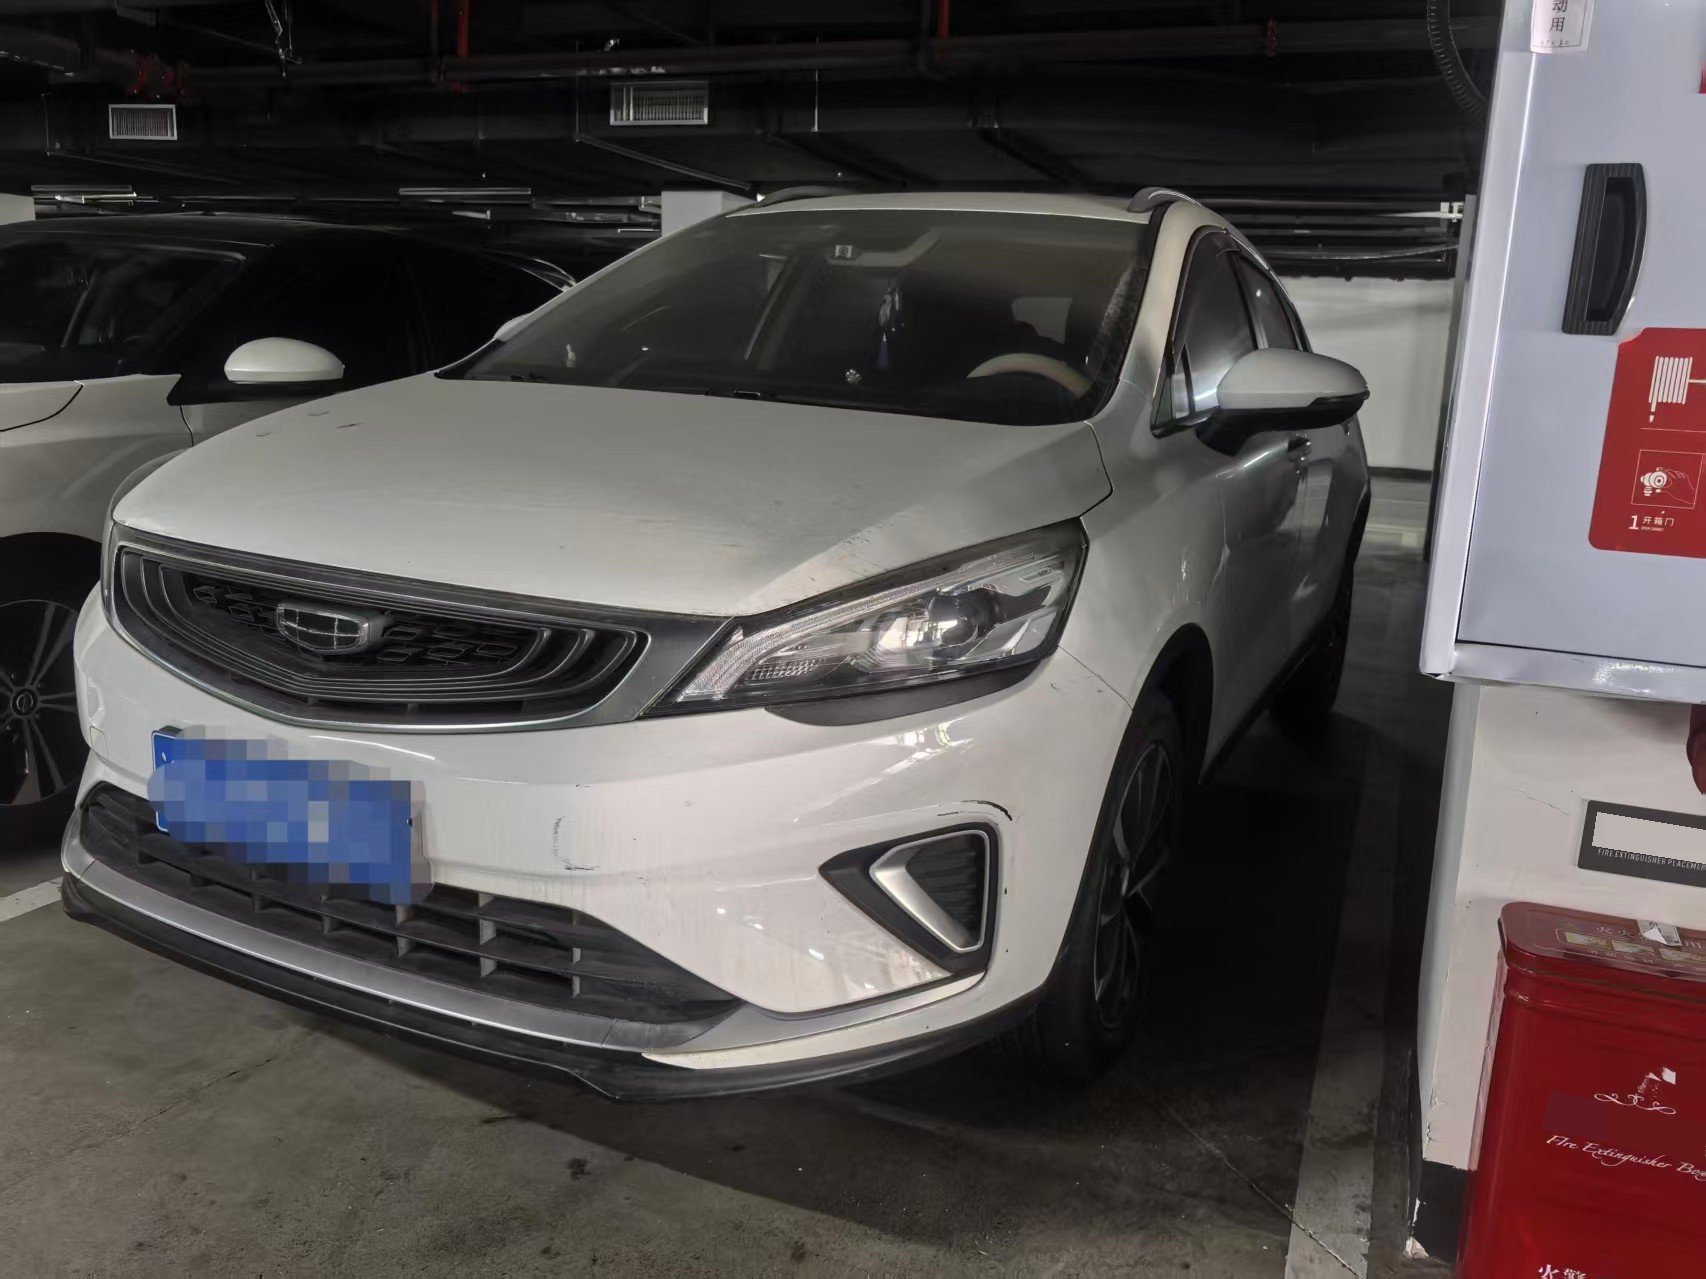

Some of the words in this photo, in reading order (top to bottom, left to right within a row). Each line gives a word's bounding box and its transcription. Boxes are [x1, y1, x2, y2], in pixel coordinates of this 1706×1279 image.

[1628, 515, 1639, 530] 1
[1642, 516, 1675, 527] 开箱门
[1597, 848, 1614, 858] FIRE
[1614, 850, 1666, 865] EXTINGUISHER
[1582, 1142, 1673, 1168] Extinguisher
